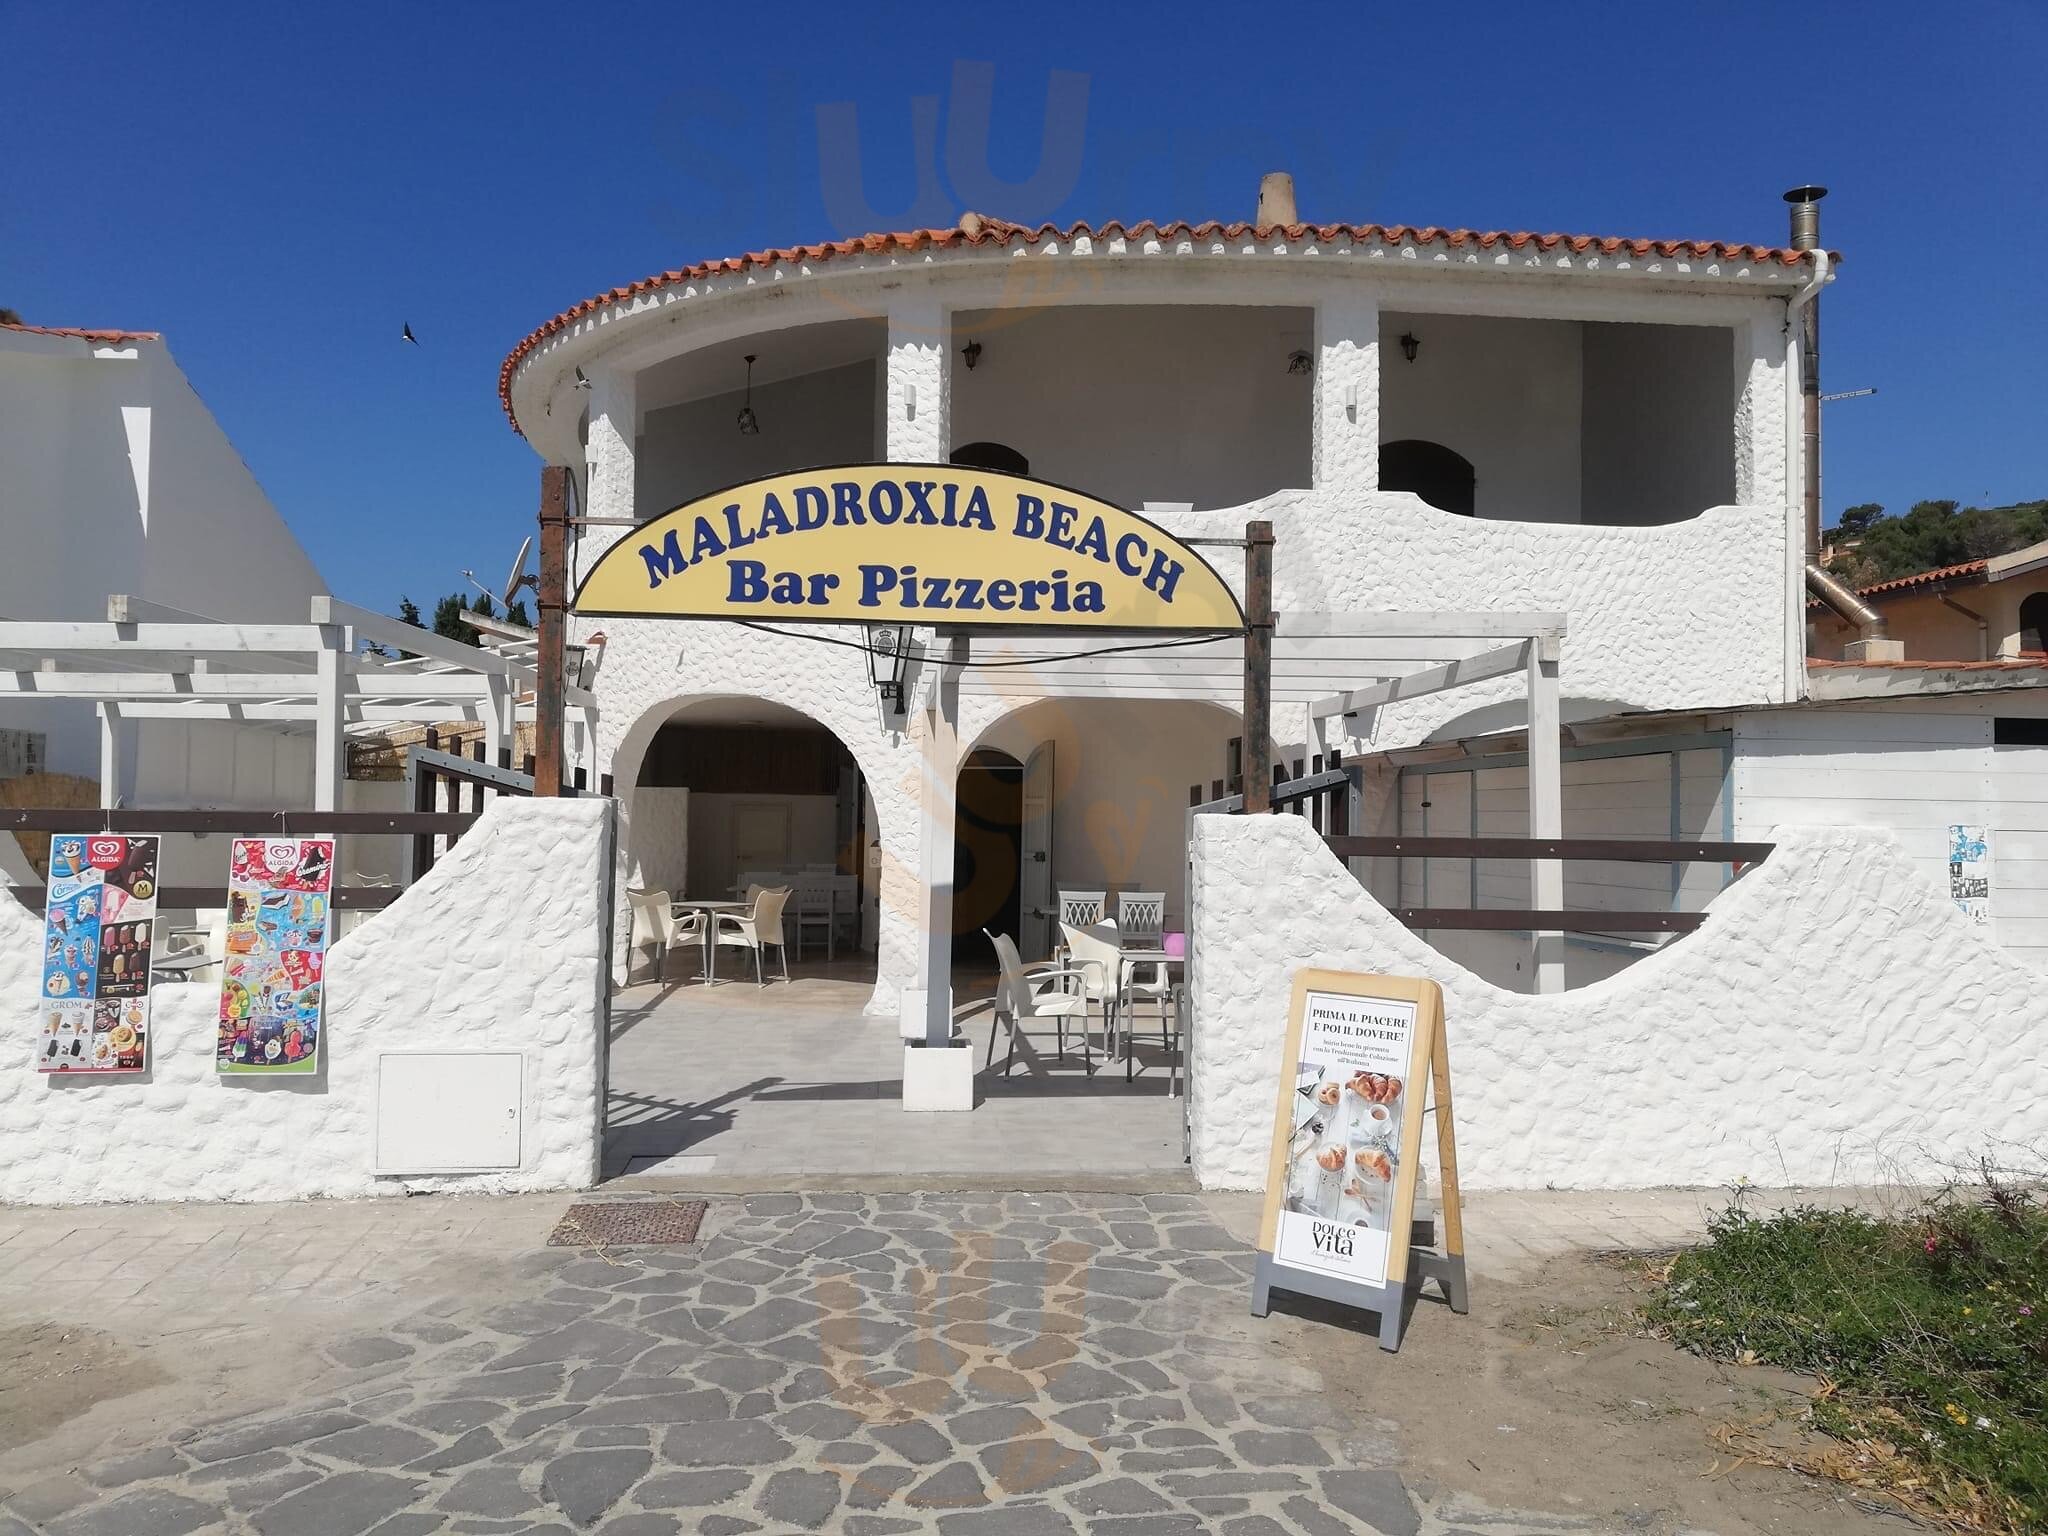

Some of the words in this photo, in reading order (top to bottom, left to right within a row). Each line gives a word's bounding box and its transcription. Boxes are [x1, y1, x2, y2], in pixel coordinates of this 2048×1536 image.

[638, 480, 996, 589] MALADROXIA
[1013, 493, 1186, 603] BEACH
[726, 559, 840, 606] Bar
[858, 563, 1106, 614] Pizzeria
[91, 856, 120, 864] ALGIDA
[51, 1000, 82, 1010] GROM
[1312, 1009, 1346, 1021] PRIMA
[1349, 1013, 1359, 1022] IL
[1361, 1015, 1408, 1028] PIACERE
[1313, 1022, 1321, 1031] E
[1322, 1023, 1342, 1034] POI
[1343, 1026, 1353, 1035] IL
[1356, 1028, 1404, 1041] DOVERE!
[1313, 1232, 1354, 1257] Vita
